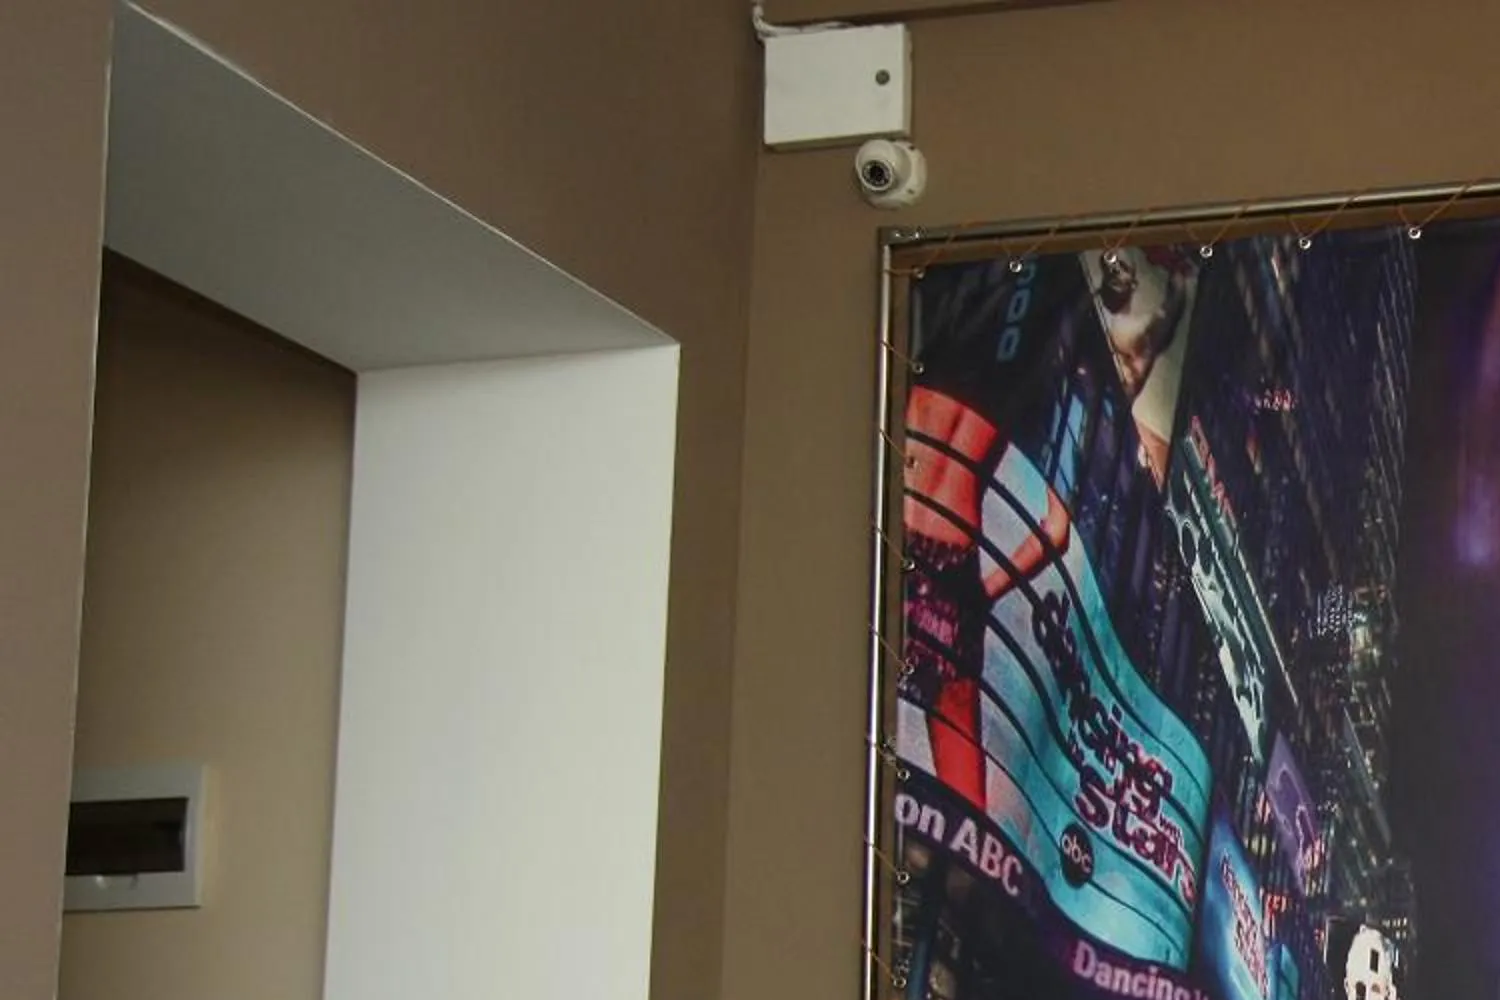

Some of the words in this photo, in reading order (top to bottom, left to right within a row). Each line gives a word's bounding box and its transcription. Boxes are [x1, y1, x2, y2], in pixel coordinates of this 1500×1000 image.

[894, 793, 946, 843] on
[950, 816, 1023, 897] ABC
[1061, 834, 1092, 875] abc
